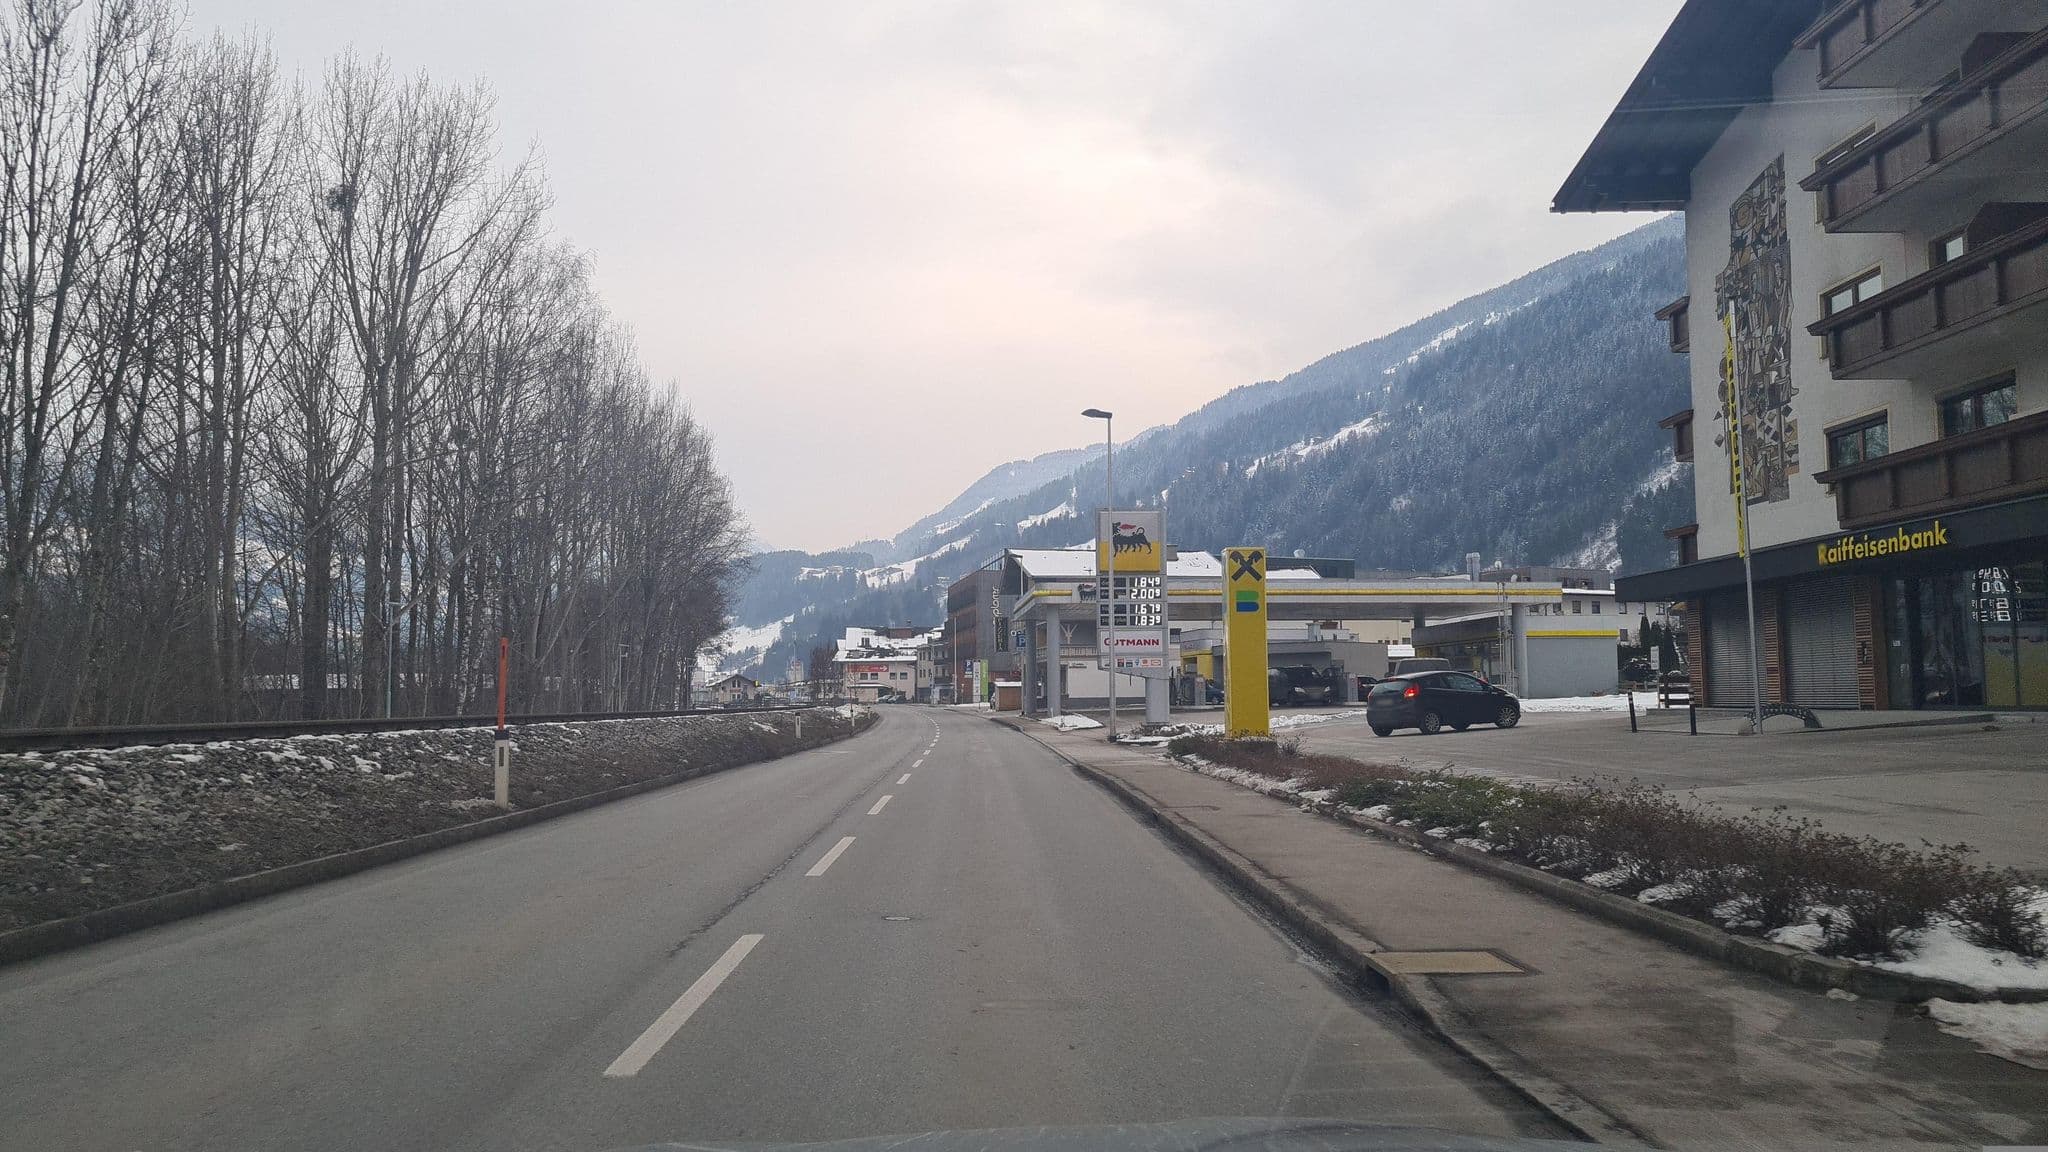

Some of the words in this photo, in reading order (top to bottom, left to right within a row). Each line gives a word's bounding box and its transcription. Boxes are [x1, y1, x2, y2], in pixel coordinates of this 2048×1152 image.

[1817, 520, 1948, 566] Raiffeisenbank
[1130, 588, 1161, 599] 2.009
[1134, 615, 1161, 626] 1.839
